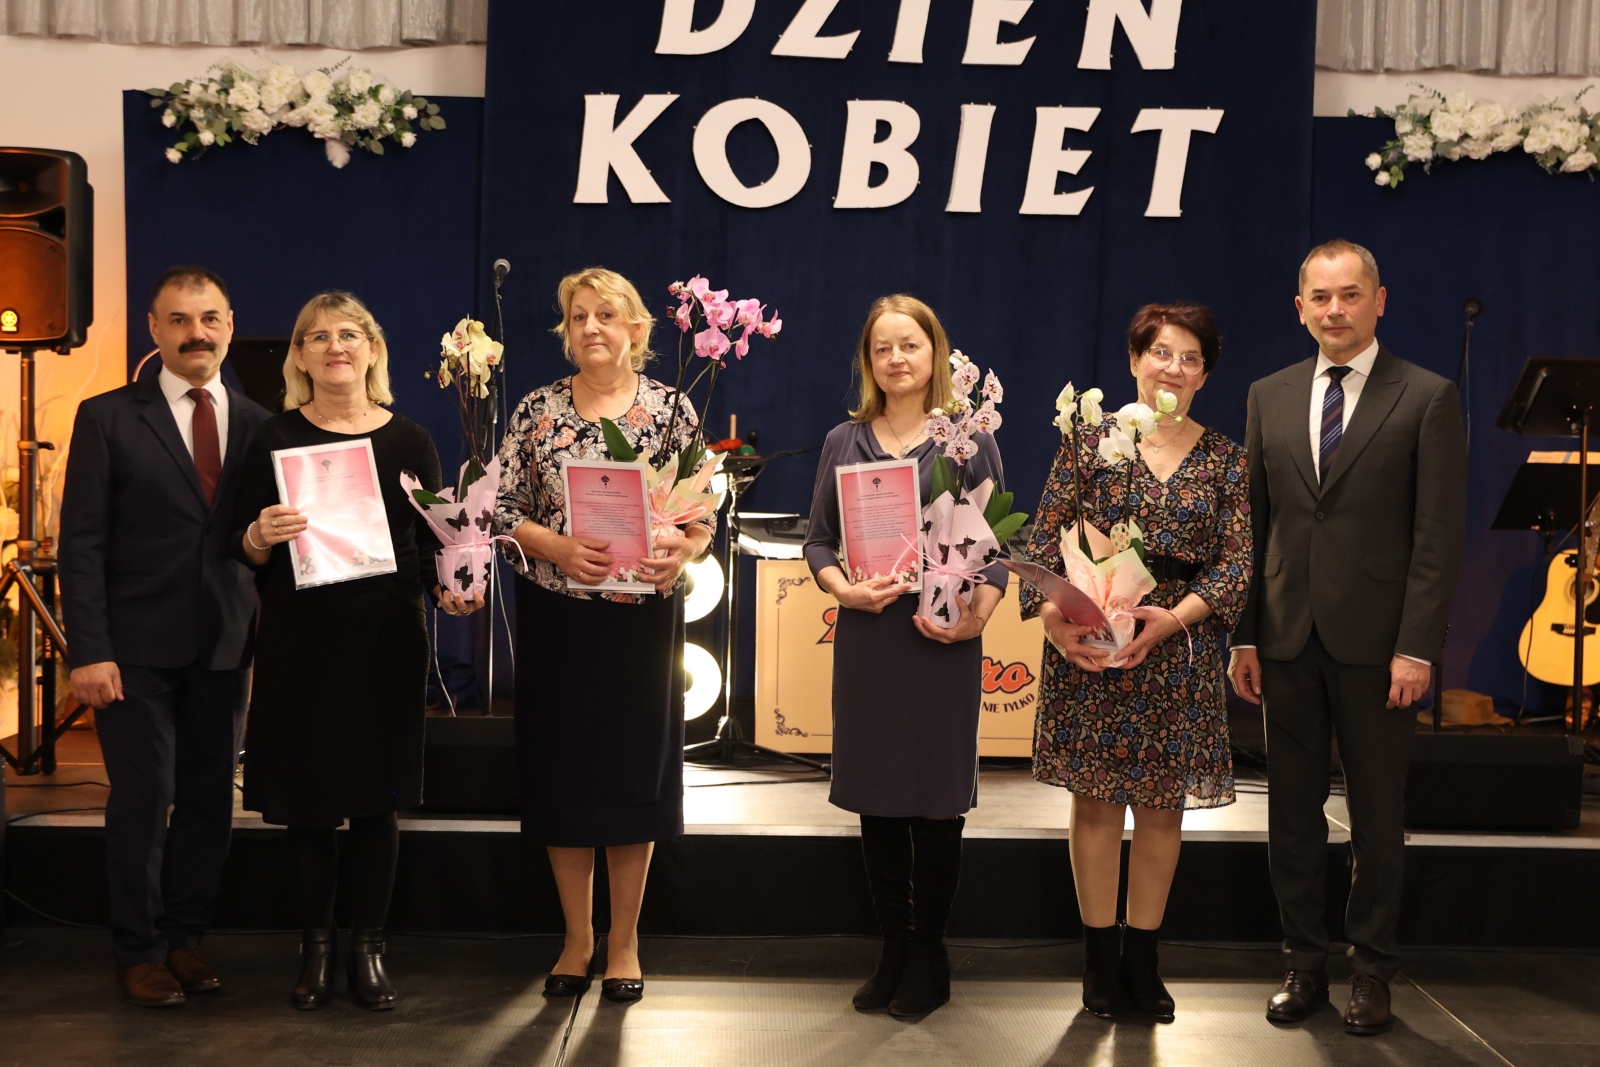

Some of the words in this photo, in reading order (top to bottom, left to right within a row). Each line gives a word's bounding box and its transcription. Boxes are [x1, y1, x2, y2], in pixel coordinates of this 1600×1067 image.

[573, 93, 1224, 218] KOBIET
[981, 701, 1000, 713] NIE
[1002, 693, 1035, 713] TYLKO
